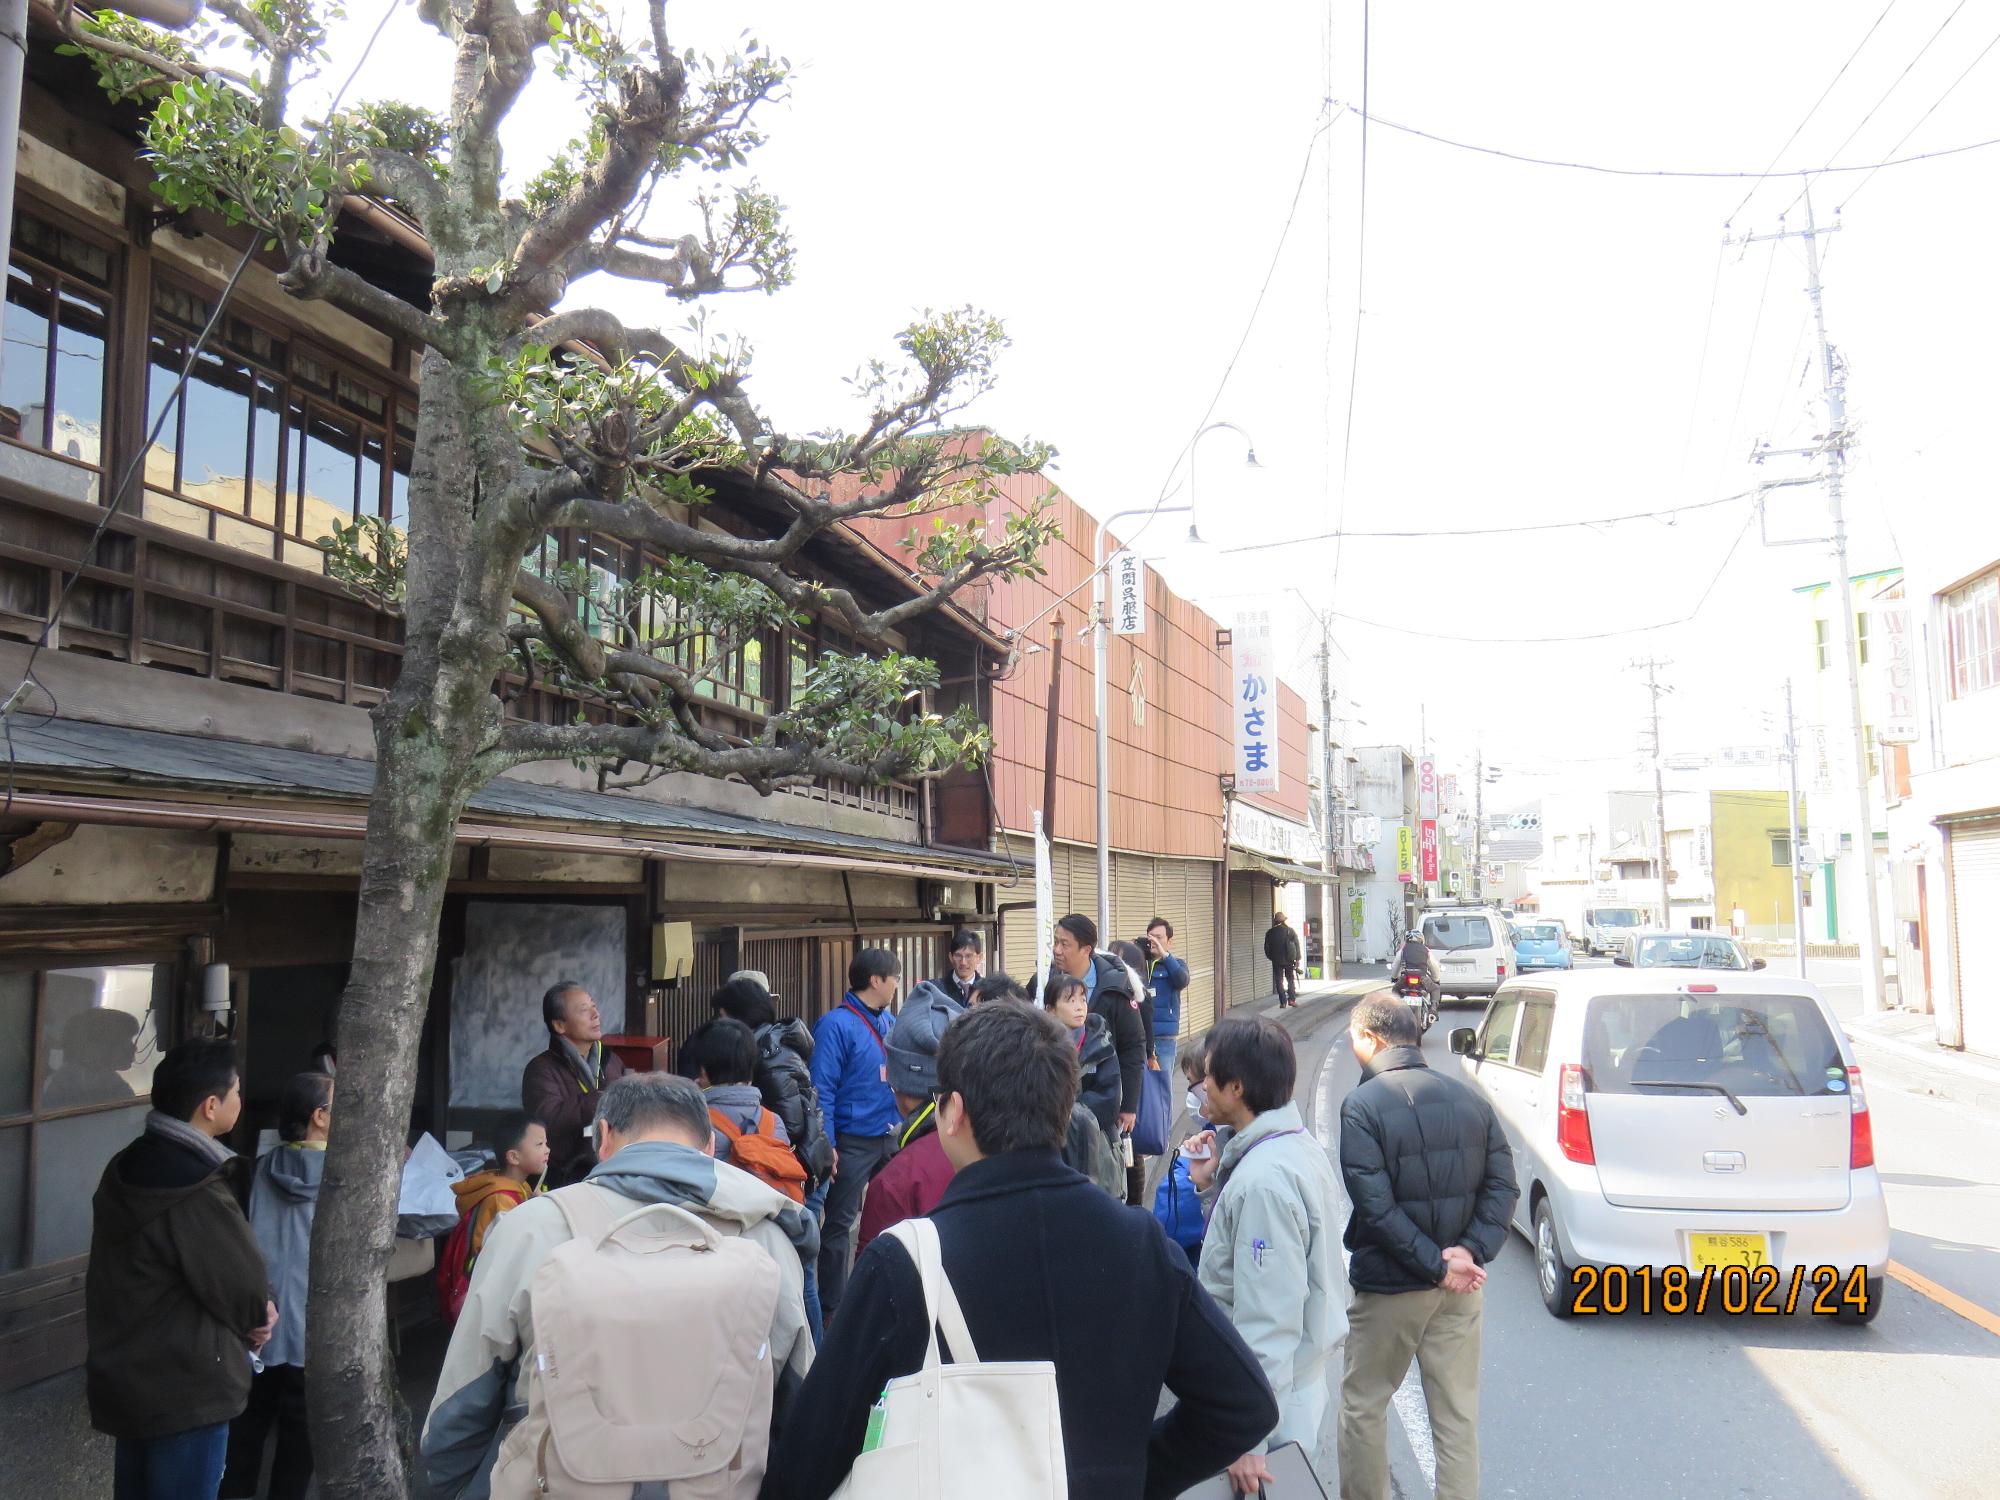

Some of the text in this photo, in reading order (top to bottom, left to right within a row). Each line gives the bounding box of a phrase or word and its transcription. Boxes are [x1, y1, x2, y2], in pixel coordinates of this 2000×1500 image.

[1120, 556, 1138, 631] 笠間呉服店
[1241, 673, 1269, 773] かさま
